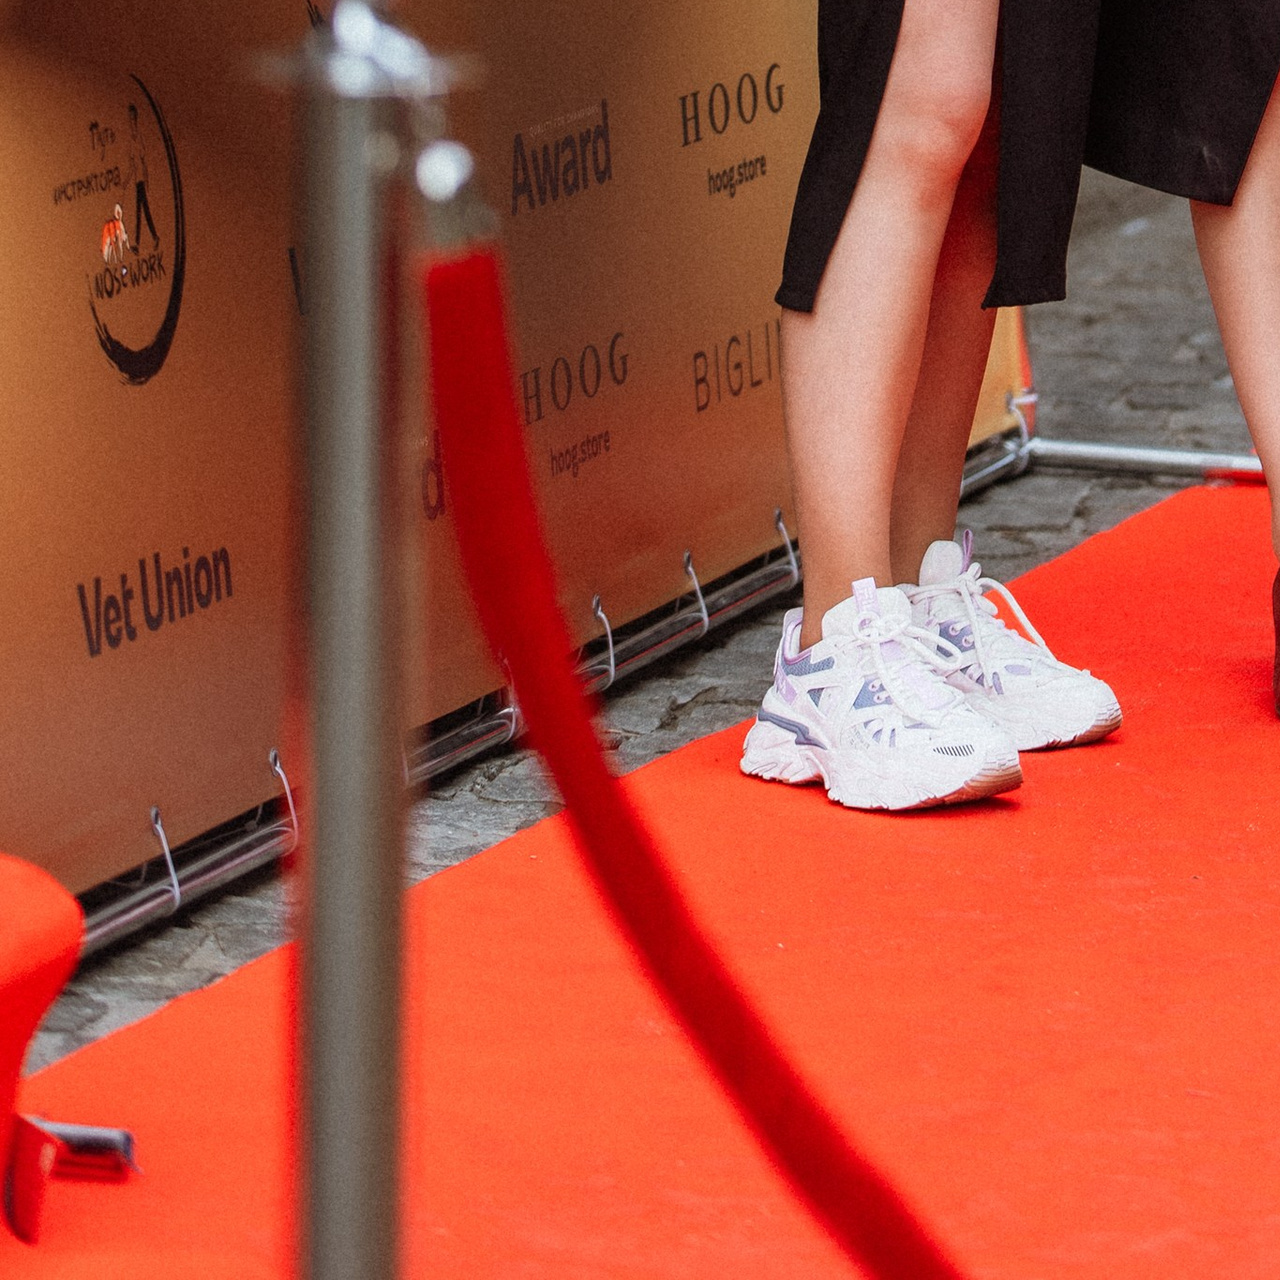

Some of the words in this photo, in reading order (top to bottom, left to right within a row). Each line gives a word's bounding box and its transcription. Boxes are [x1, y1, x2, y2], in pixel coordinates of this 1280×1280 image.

[679, 63, 785, 147] HOOG
[512, 98, 612, 216] Award
[707, 155, 767, 198] hoog.store
[521, 332, 630, 425] HOOG
[550, 429, 611, 477] hoog.store
[77, 576, 137, 658] Vet
[139, 546, 233, 631] Union
